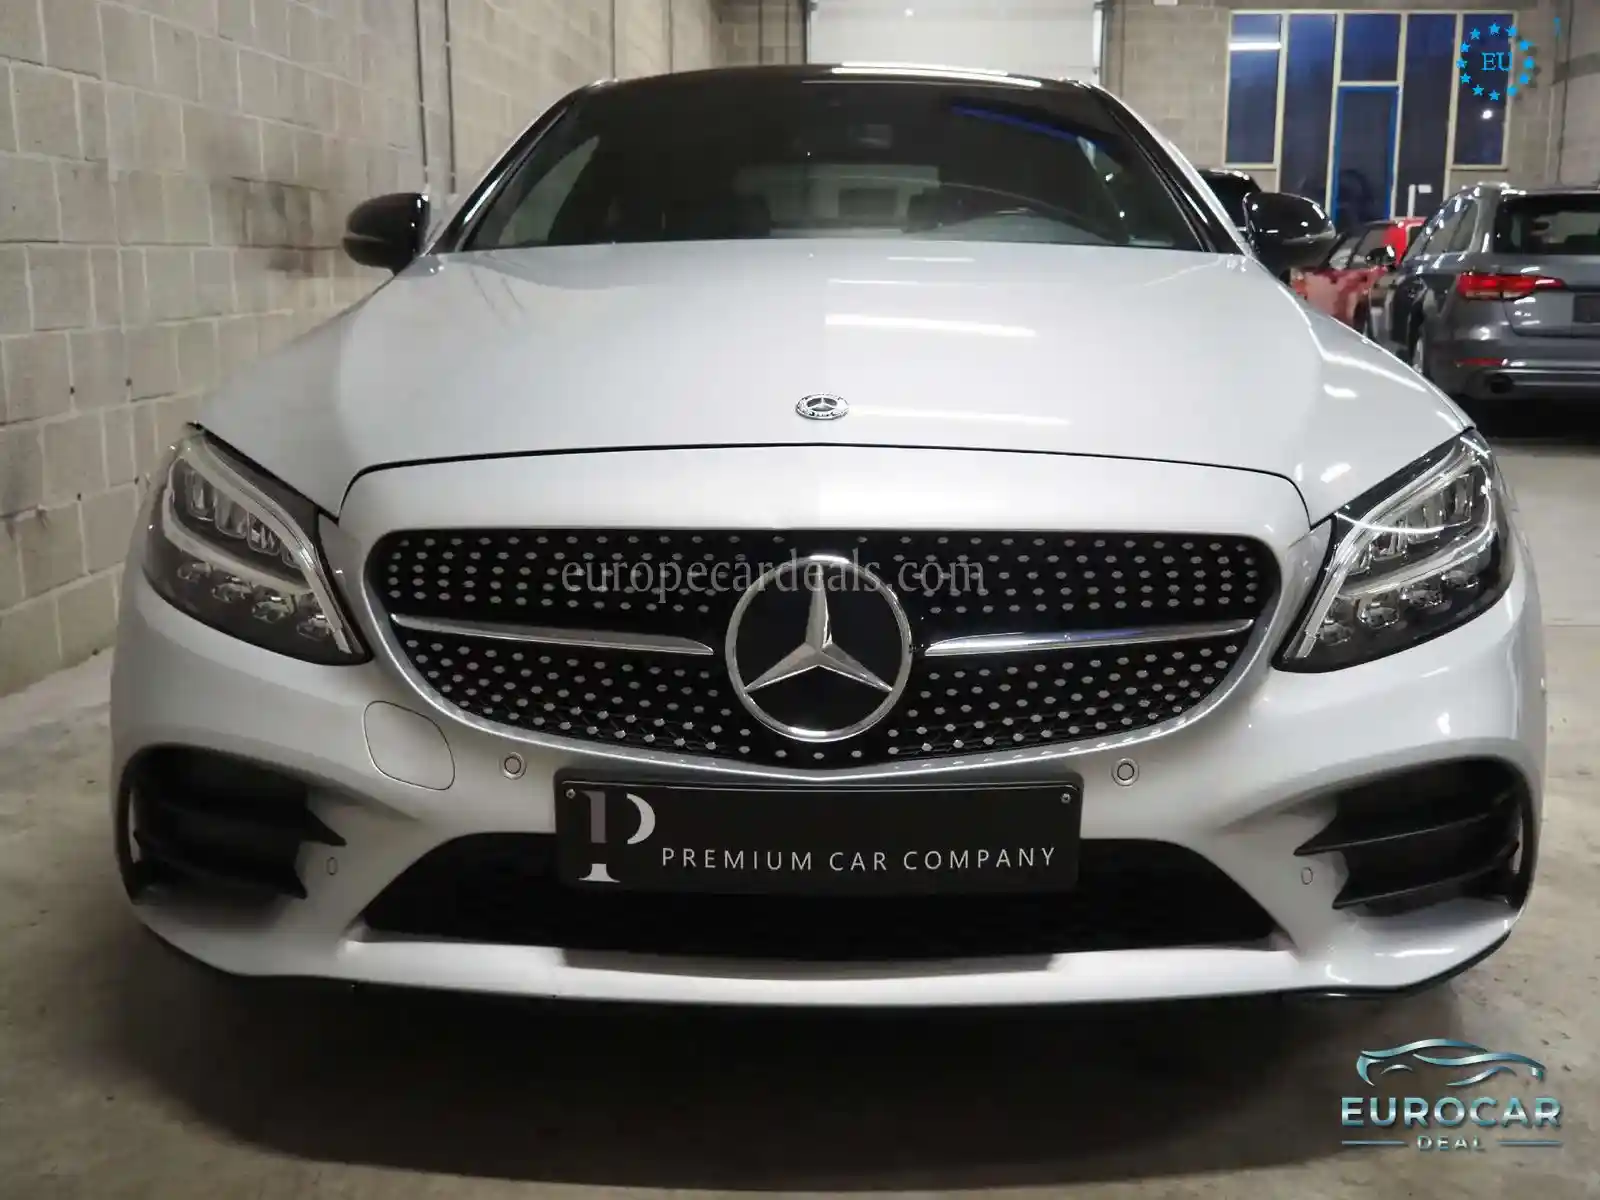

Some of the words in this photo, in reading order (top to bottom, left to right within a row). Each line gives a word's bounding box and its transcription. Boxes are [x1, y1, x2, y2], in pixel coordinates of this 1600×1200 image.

[662, 847, 812, 871] PREMIUM
[829, 852, 887, 871] CAR
[903, 847, 1055, 870] COMPANY
